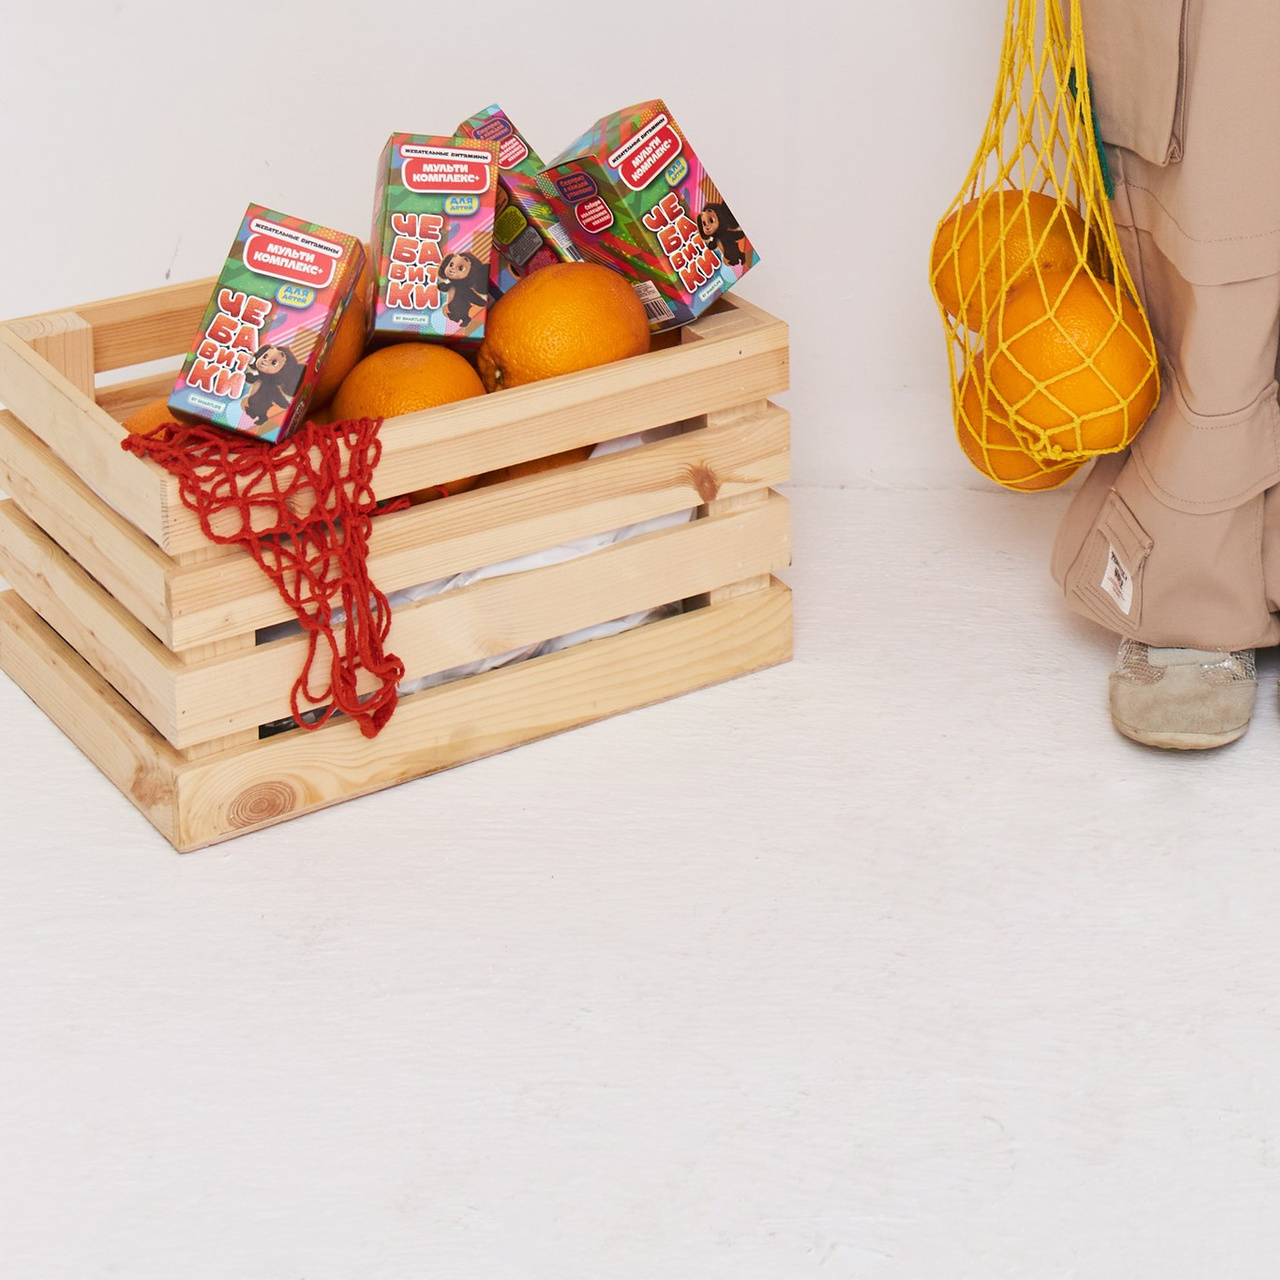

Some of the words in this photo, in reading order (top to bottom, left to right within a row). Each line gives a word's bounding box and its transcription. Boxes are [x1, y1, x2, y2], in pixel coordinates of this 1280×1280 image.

[631, 136, 662, 168] МУЛЬТИ
[412, 172, 480, 183] КОМПЛЕКС+
[422, 163, 468, 173] МУЛЬТИ
[450, 196, 473, 205] ДЛЯ
[642, 192, 685, 231] ЧЕ
[254, 222, 299, 242] ЖЕВАТЕЛЬНЫЕ
[300, 236, 340, 255] ВИТАМИНЫ
[391, 213, 443, 241] ЧЕ
[657, 215, 699, 256] БА
[253, 252, 324, 275] КОМПЛЕКС+
[266, 243, 316, 263] МУЛЬТИ
[391, 236, 442, 267] БА
[669, 234, 706, 272] ВИТ
[388, 263, 439, 284] ВИТ
[678, 248, 721, 293] КИ
[284, 284, 310, 298] ДЛЯ
[386, 281, 441, 310] КИ
[218, 289, 272, 329] ЧЕ
[205, 313, 259, 353] БА
[197, 339, 252, 372] ВИТ
[186, 359, 246, 399] КИ
